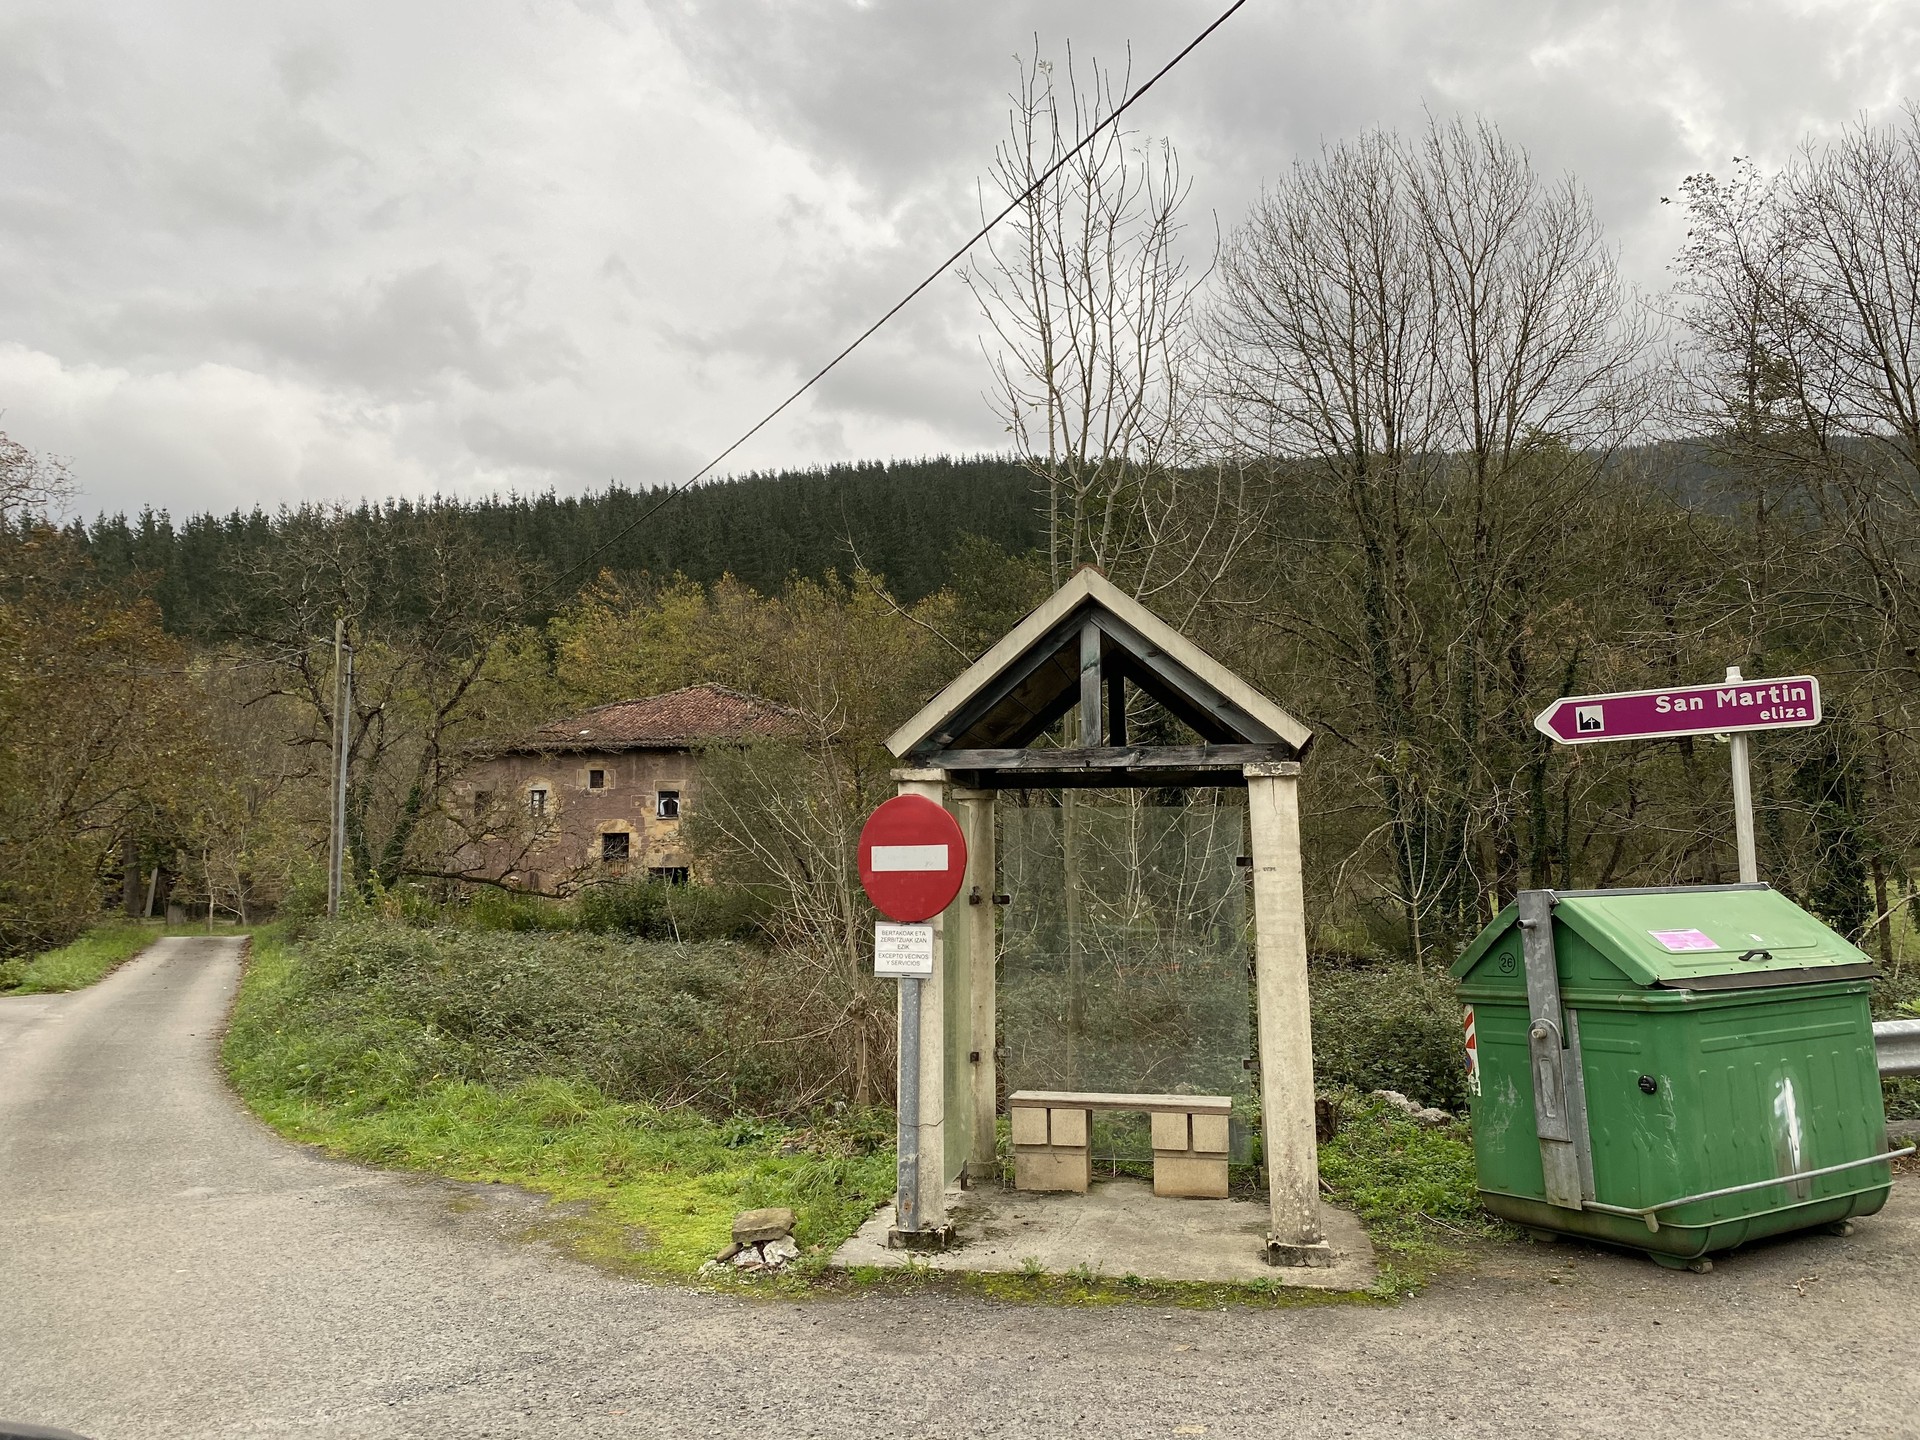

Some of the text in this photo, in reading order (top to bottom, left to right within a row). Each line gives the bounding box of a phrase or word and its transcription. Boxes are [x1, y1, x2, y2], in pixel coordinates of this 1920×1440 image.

[1655, 684, 1806, 713] San Martin
[1759, 706, 1808, 720] eliza
[1500, 957, 1513, 968] 26
